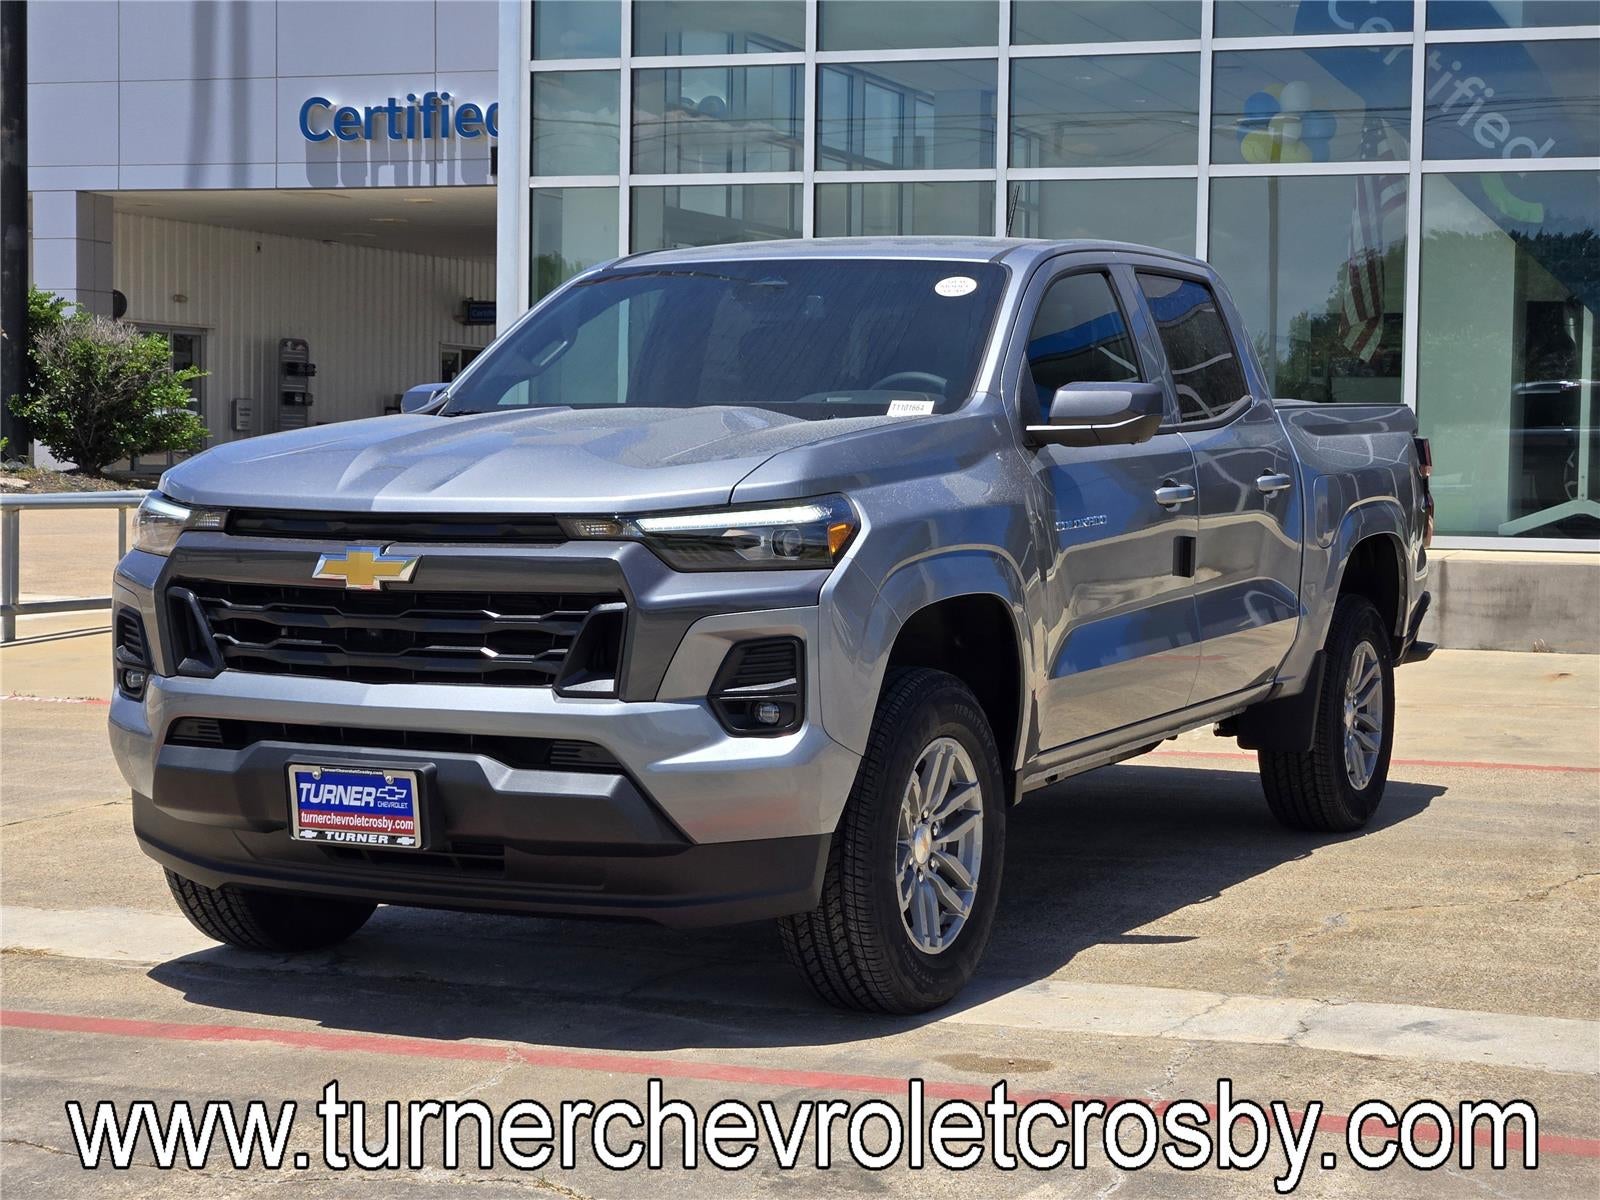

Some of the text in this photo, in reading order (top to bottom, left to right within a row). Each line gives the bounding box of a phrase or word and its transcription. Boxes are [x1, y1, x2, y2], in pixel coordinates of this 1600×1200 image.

[299, 782, 376, 807] TURNER
[377, 801, 408, 809] CHEVROLET
[301, 811, 414, 831] turnerchevroletcrosby.com
[324, 831, 389, 844] TURNER
